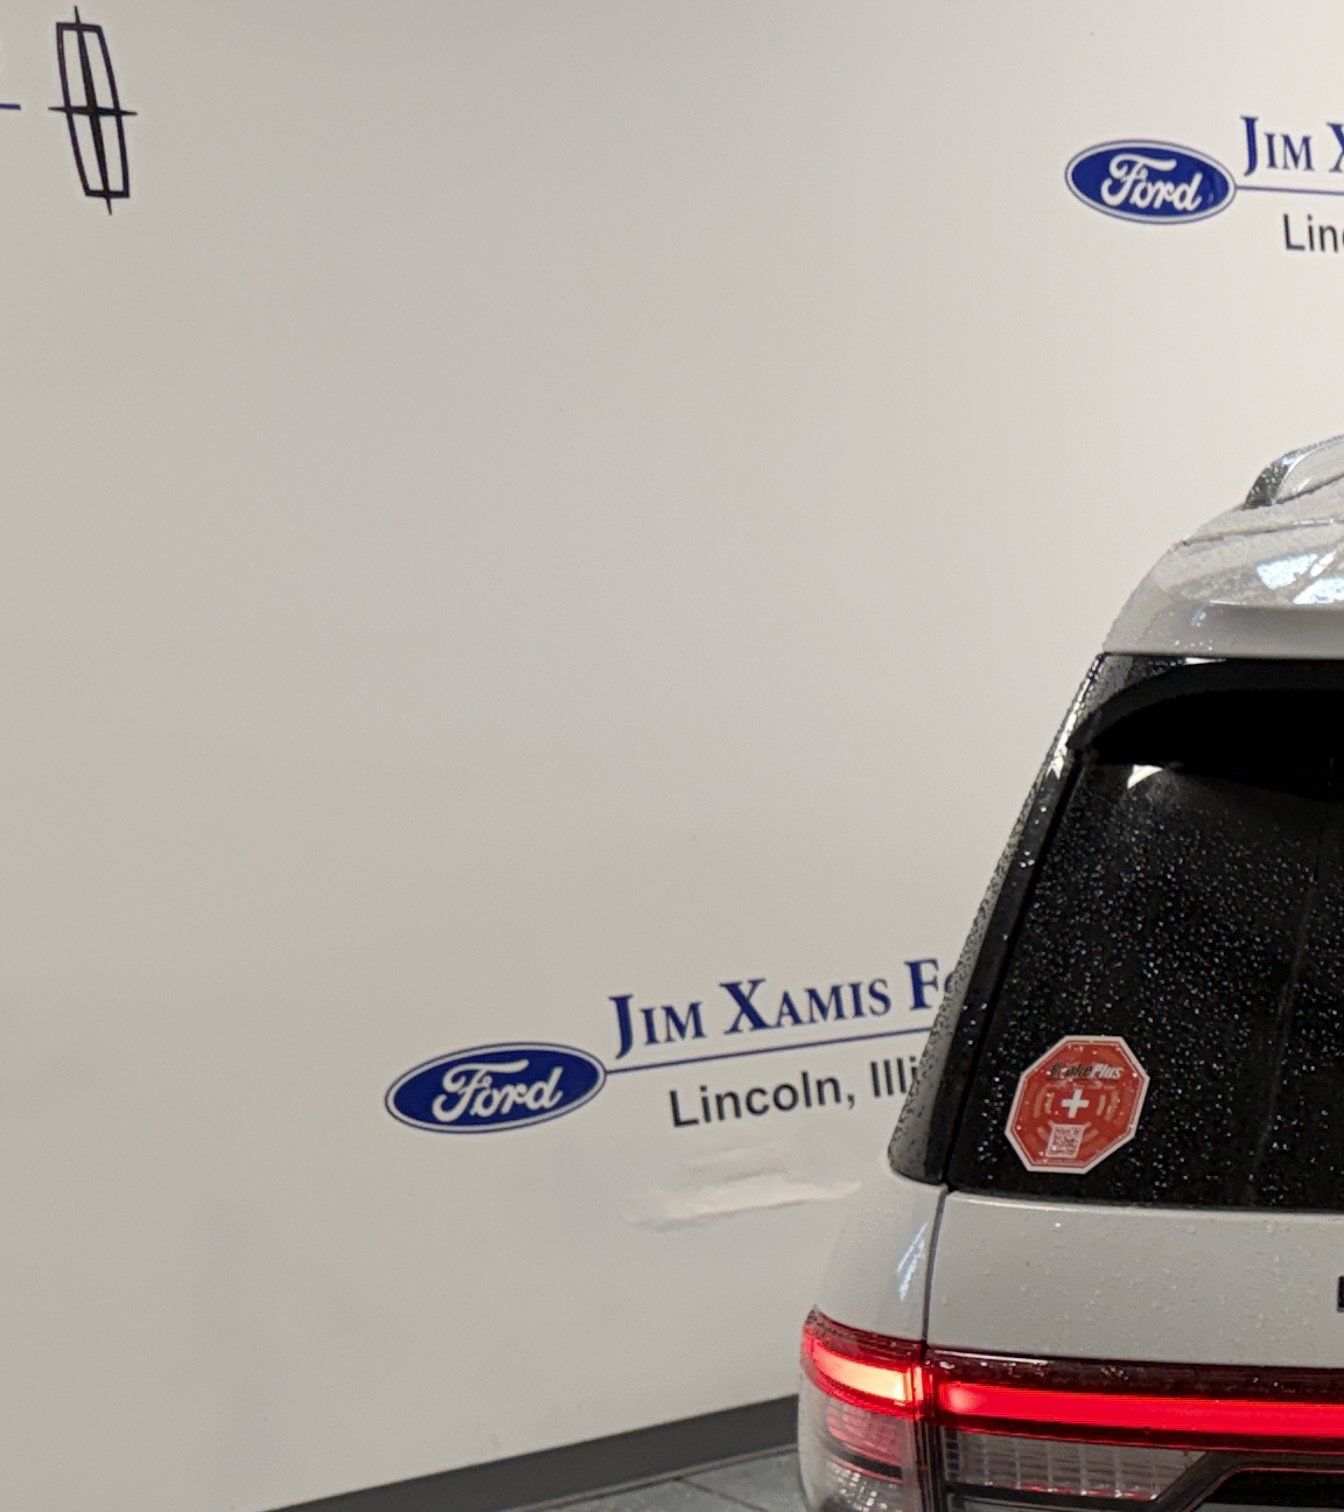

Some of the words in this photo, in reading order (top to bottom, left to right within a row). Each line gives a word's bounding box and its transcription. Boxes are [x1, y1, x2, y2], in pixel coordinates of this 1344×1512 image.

[1240, 115, 1312, 176] JIM
[1101, 154, 1202, 211] Ford
[609, 994, 705, 1059] JIM
[719, 978, 891, 1034] XAMIS
[432, 1059, 563, 1122] Ford
[670, 1070, 856, 1127] Lincoln,
